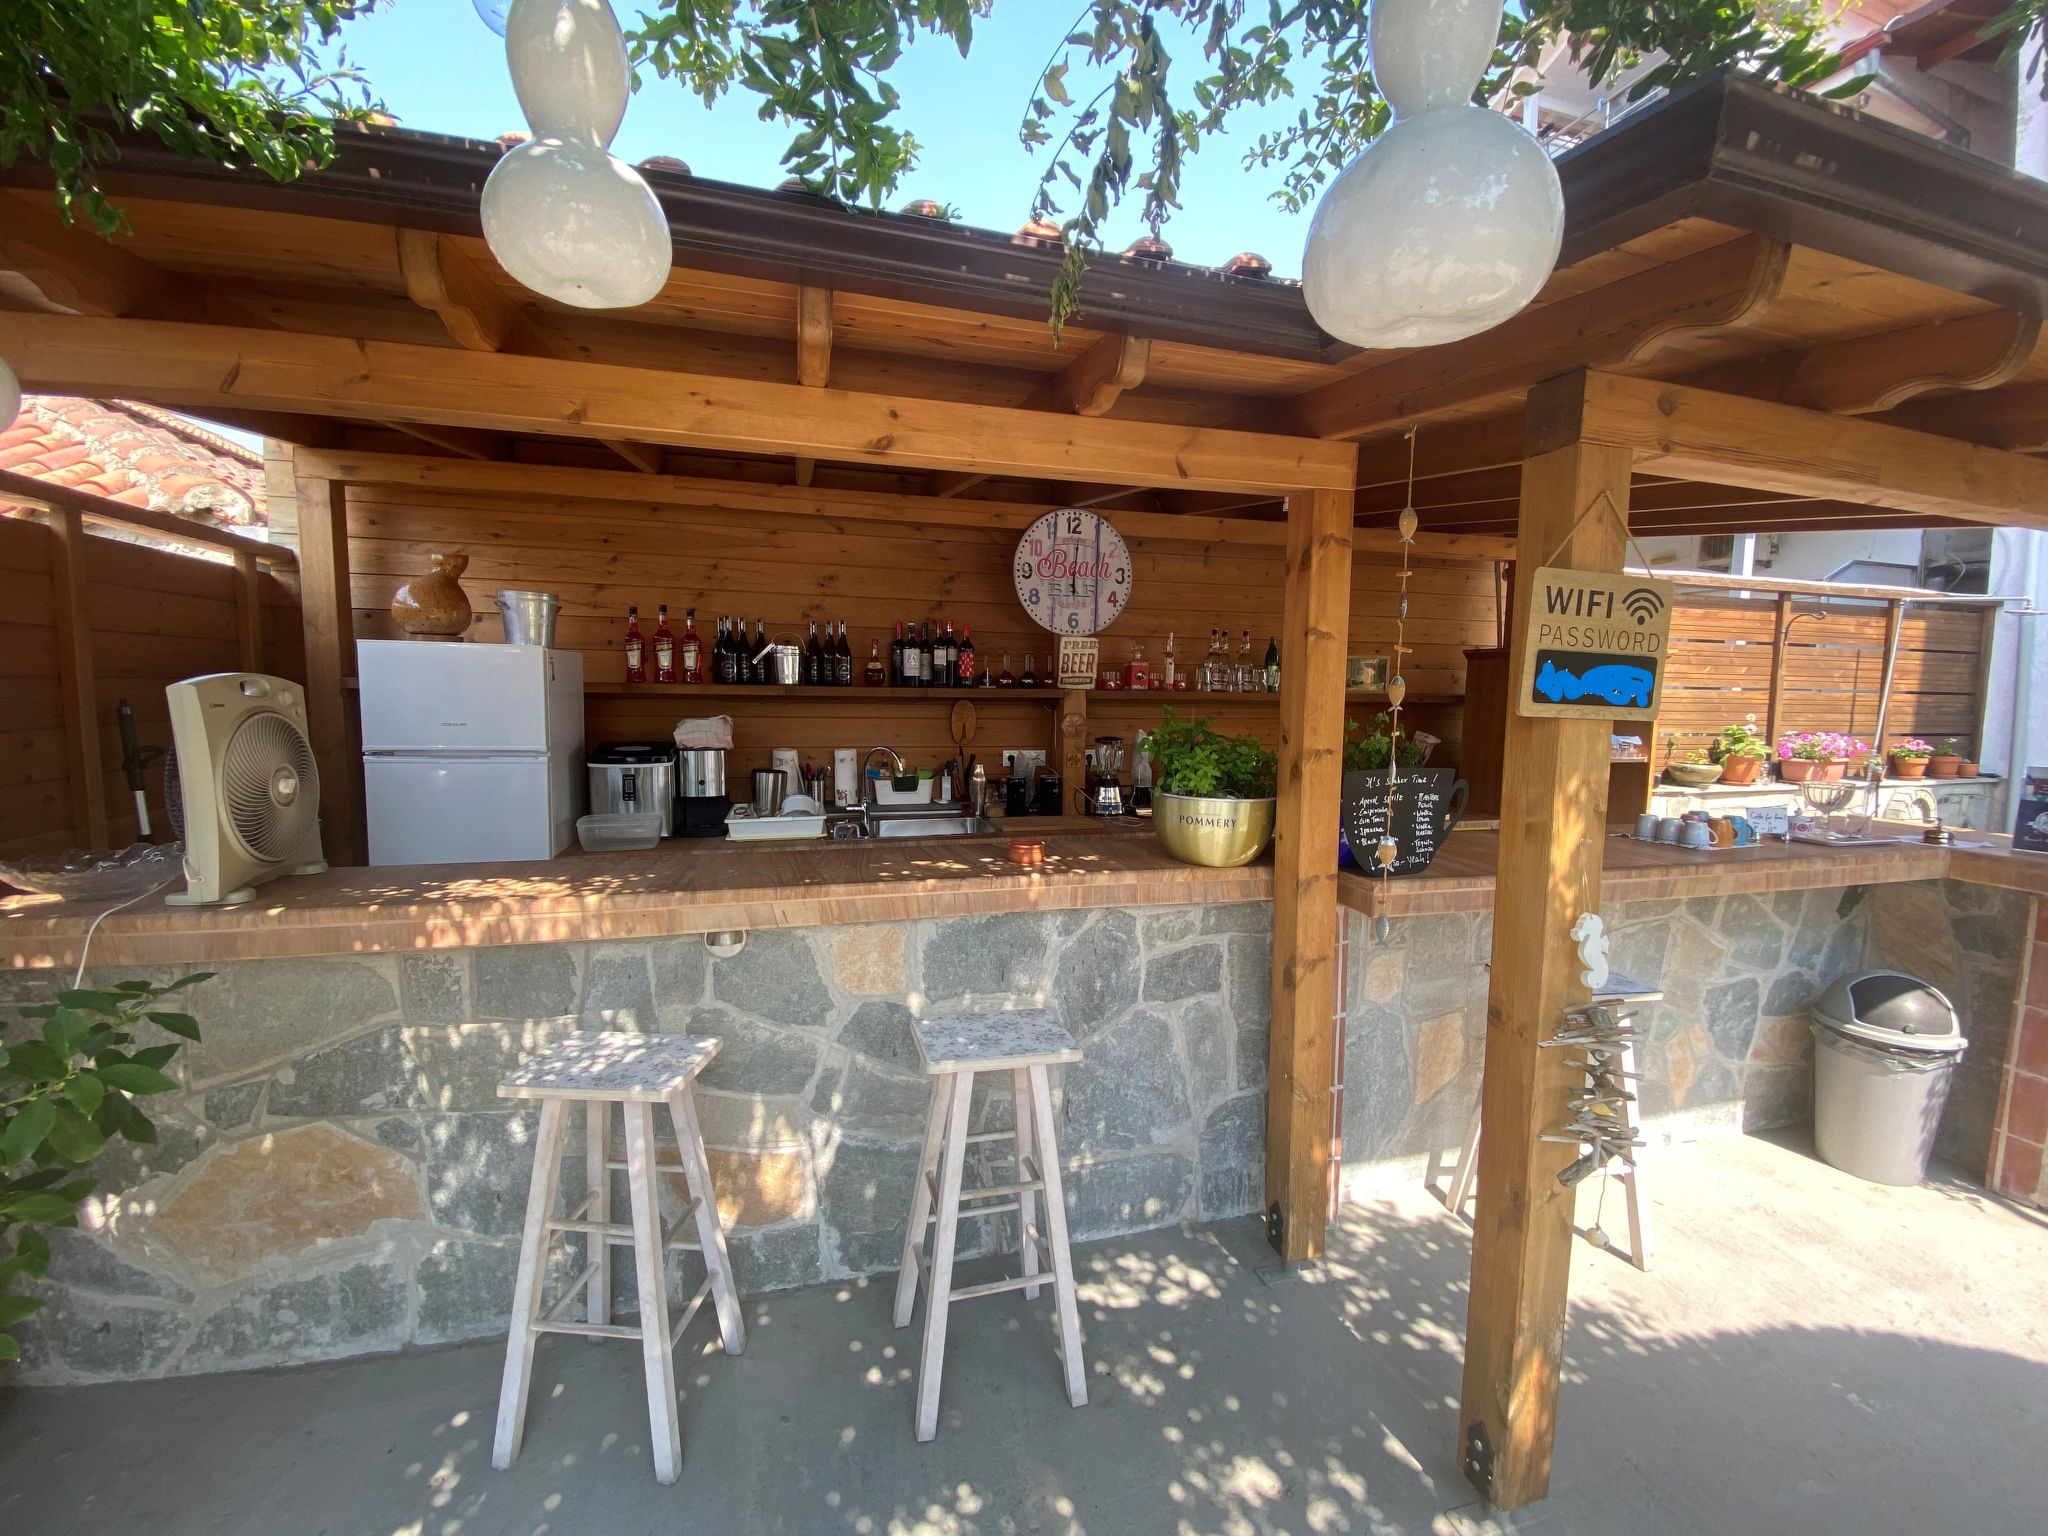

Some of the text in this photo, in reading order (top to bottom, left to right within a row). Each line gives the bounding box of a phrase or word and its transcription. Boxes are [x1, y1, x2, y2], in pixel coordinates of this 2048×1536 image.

[1066, 516, 1082, 535] 12
[1029, 539, 1043, 557] 10
[1108, 542, 1119, 558] 2
[1021, 562, 1033, 579] 9
[1036, 549, 1113, 579] Beach
[1115, 568, 1126, 584] 3
[1028, 588, 1040, 605] 8
[1107, 591, 1119, 608] 4
[1546, 586, 1614, 619] WIFI
[1067, 612, 1079, 629] 6
[1063, 640, 1099, 650] FREE
[1539, 624, 1660, 652] PASSWORD
[1061, 653, 1095, 674] BEER
[1179, 815, 1237, 828] POMMERY
